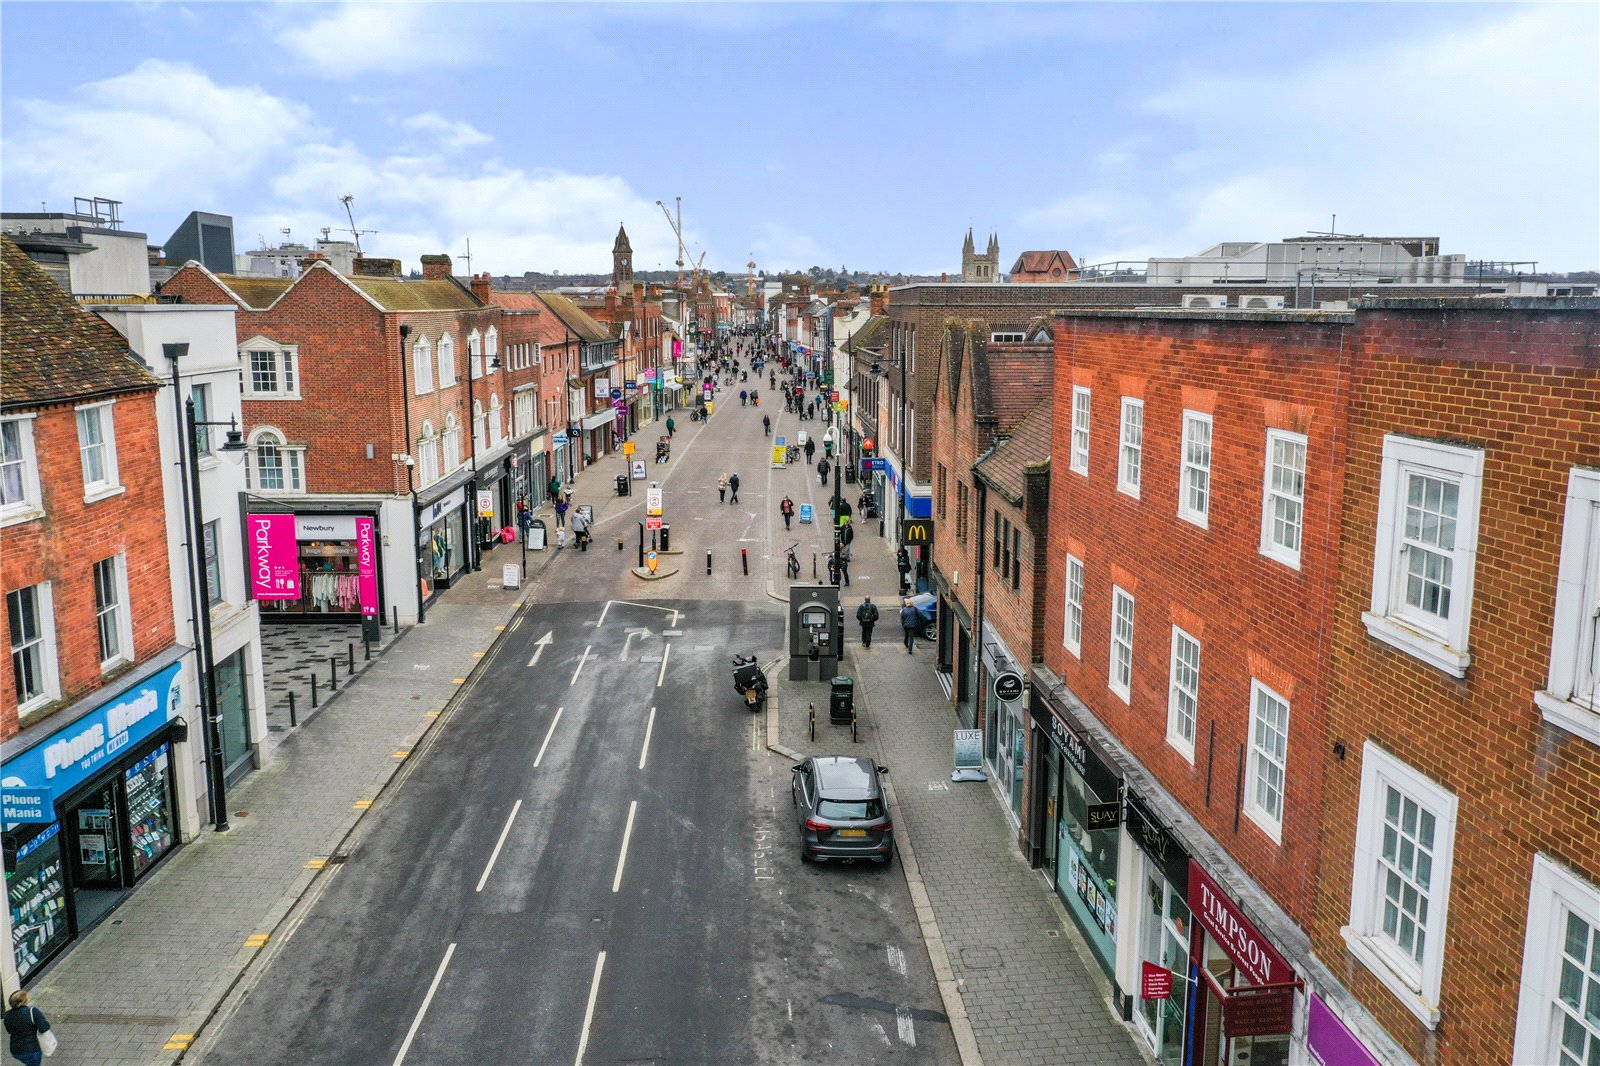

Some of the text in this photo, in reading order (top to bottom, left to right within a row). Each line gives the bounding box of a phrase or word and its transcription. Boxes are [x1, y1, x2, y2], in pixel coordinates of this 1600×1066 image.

[255, 519, 273, 589] Parkway
[360, 523, 371, 566] Parkway
[43, 689, 158, 779] Phone Mania
[955, 731, 980, 741] LUXE
[2, 794, 41, 805] Phone
[3, 808, 42, 818] Mania
[1090, 810, 1118, 822] SUAY
[1200, 883, 1272, 981] TIMPSON
[1203, 911, 1215, 928] Great
[1215, 924, 1230, 946] Service
[1237, 951, 1249, 969] Great
